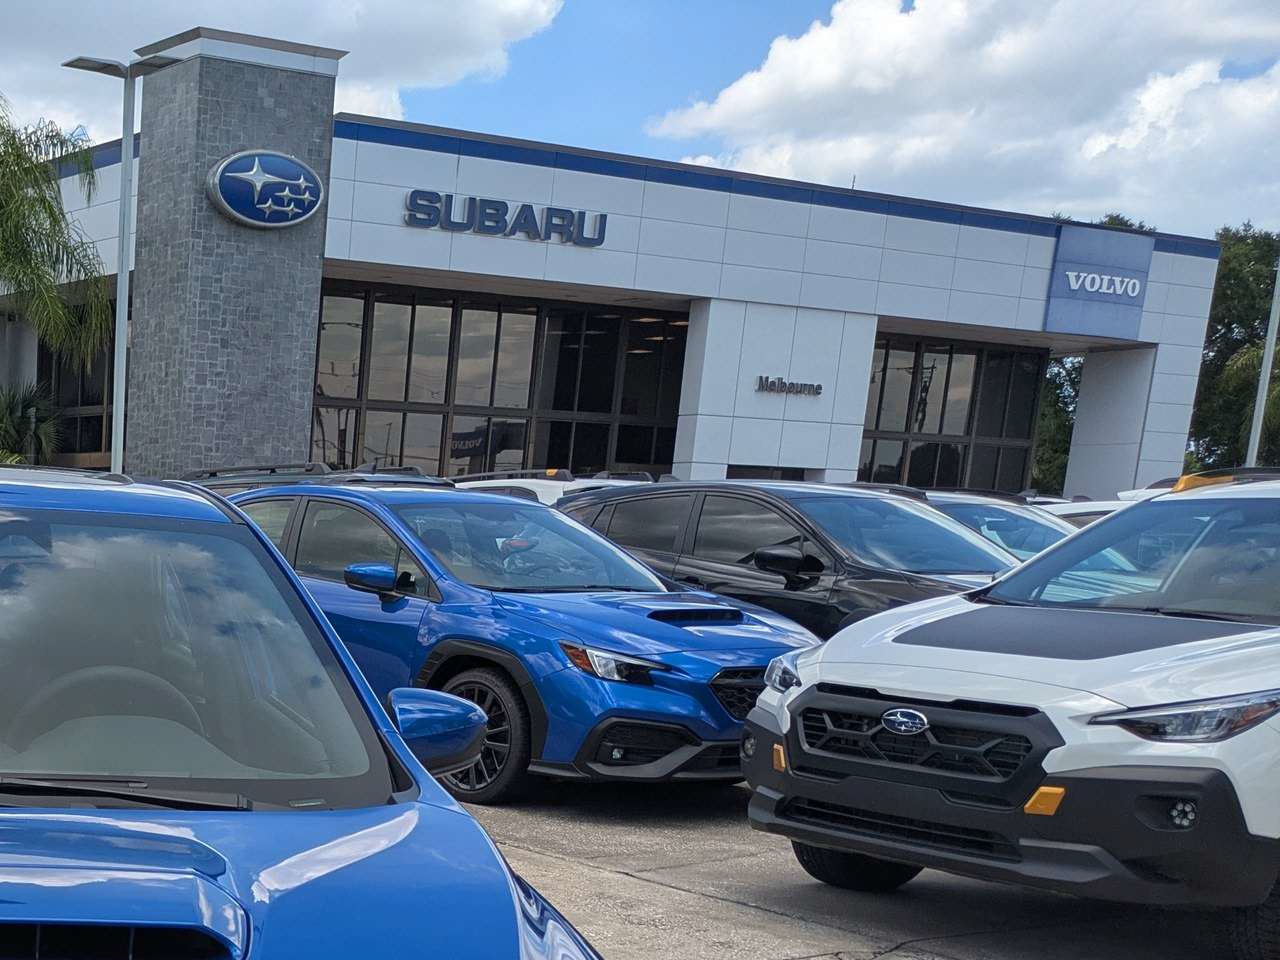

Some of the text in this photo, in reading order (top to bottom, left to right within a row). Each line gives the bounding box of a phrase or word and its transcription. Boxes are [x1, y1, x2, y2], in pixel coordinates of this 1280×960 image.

[405, 189, 607, 247] SUBARU
[1065, 271, 1140, 297] VOLVO
[755, 375, 823, 396] Melbourne
